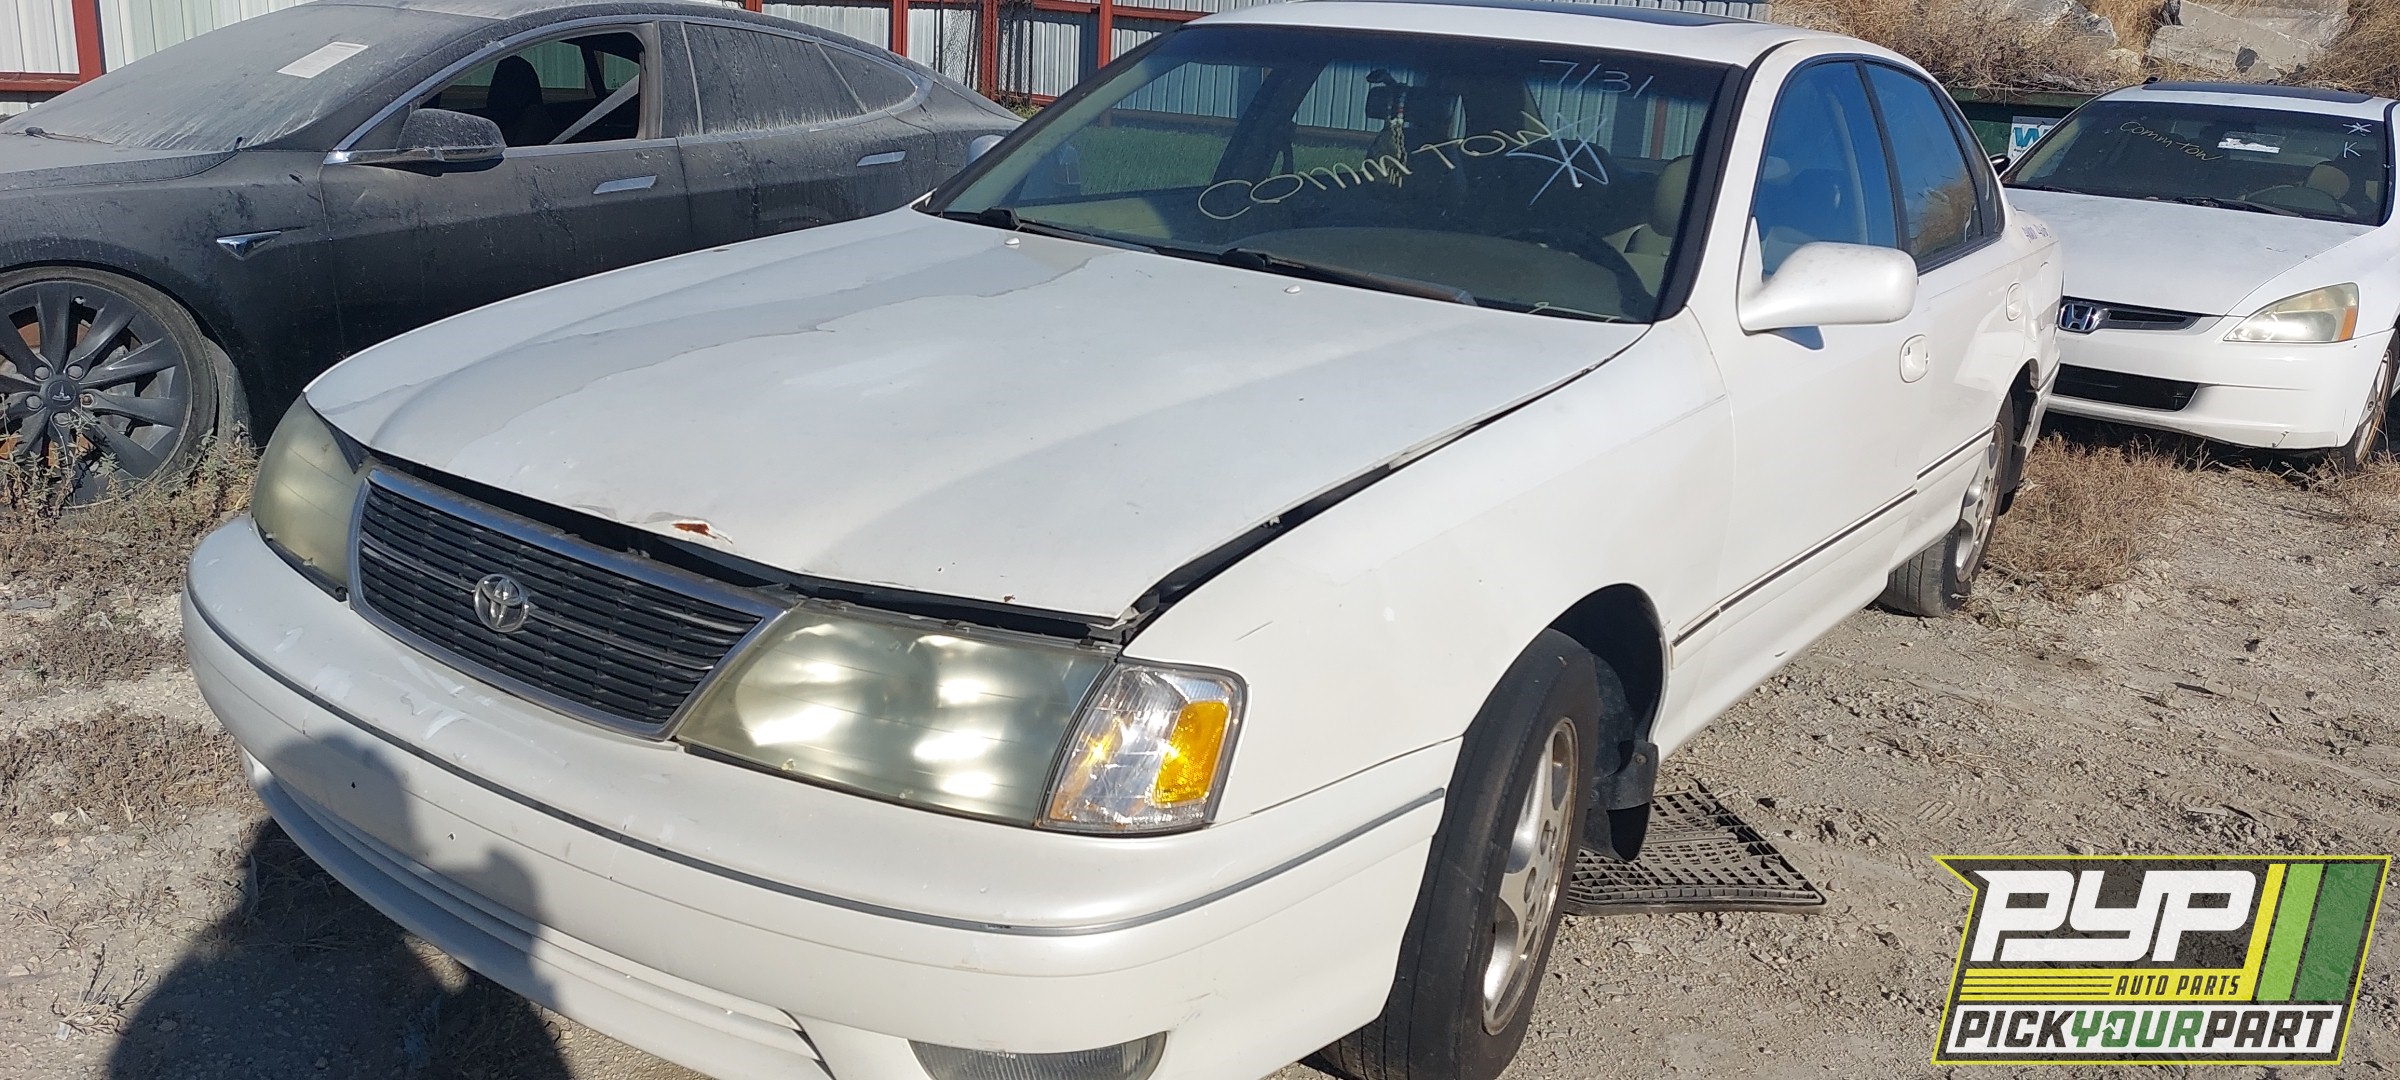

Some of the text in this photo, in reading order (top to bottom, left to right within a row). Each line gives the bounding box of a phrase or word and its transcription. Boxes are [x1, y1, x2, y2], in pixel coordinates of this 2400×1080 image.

[1538, 58, 1654, 99] 7/31
[2013, 126, 2050, 147] W
[2343, 141, 2361, 158] K
